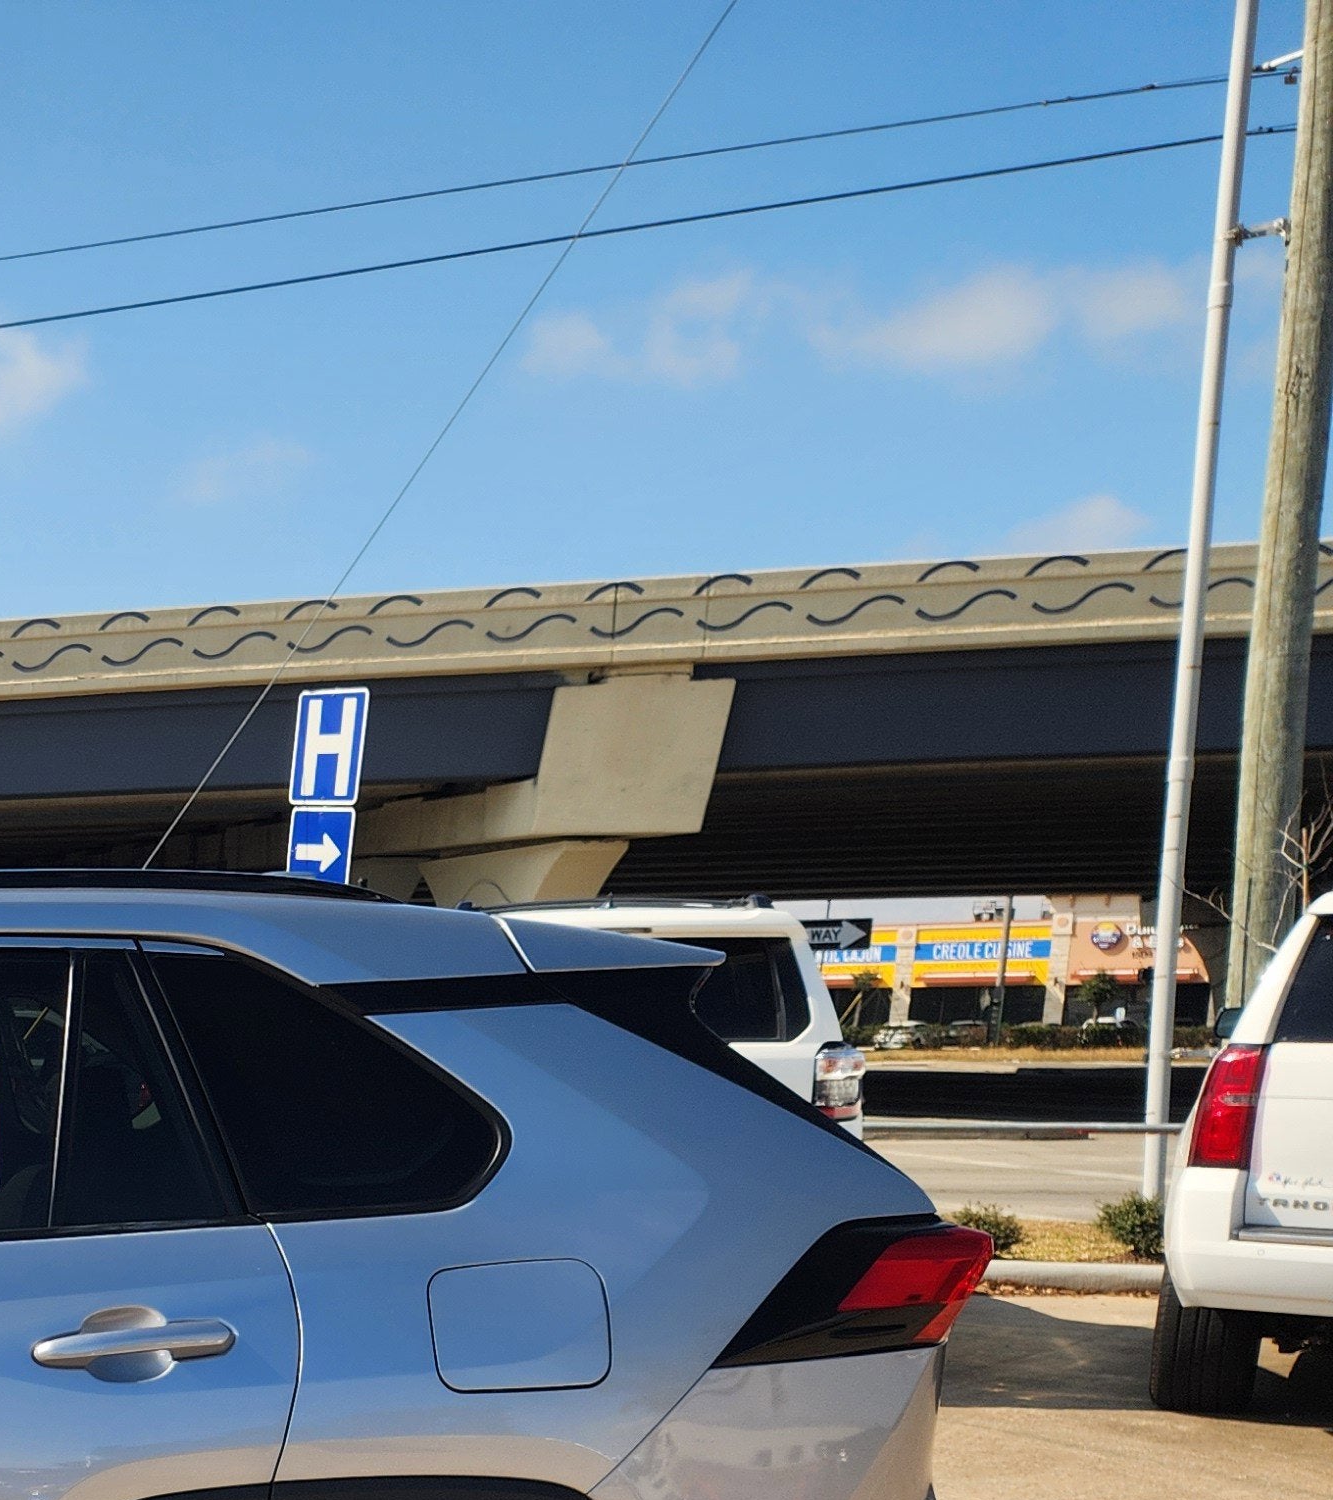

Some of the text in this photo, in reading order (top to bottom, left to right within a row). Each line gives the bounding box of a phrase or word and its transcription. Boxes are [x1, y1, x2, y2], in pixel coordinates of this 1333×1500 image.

[300, 697, 358, 797] H
[810, 929, 841, 942] WAY
[933, 940, 1033, 960] CREOLE CUSINE
